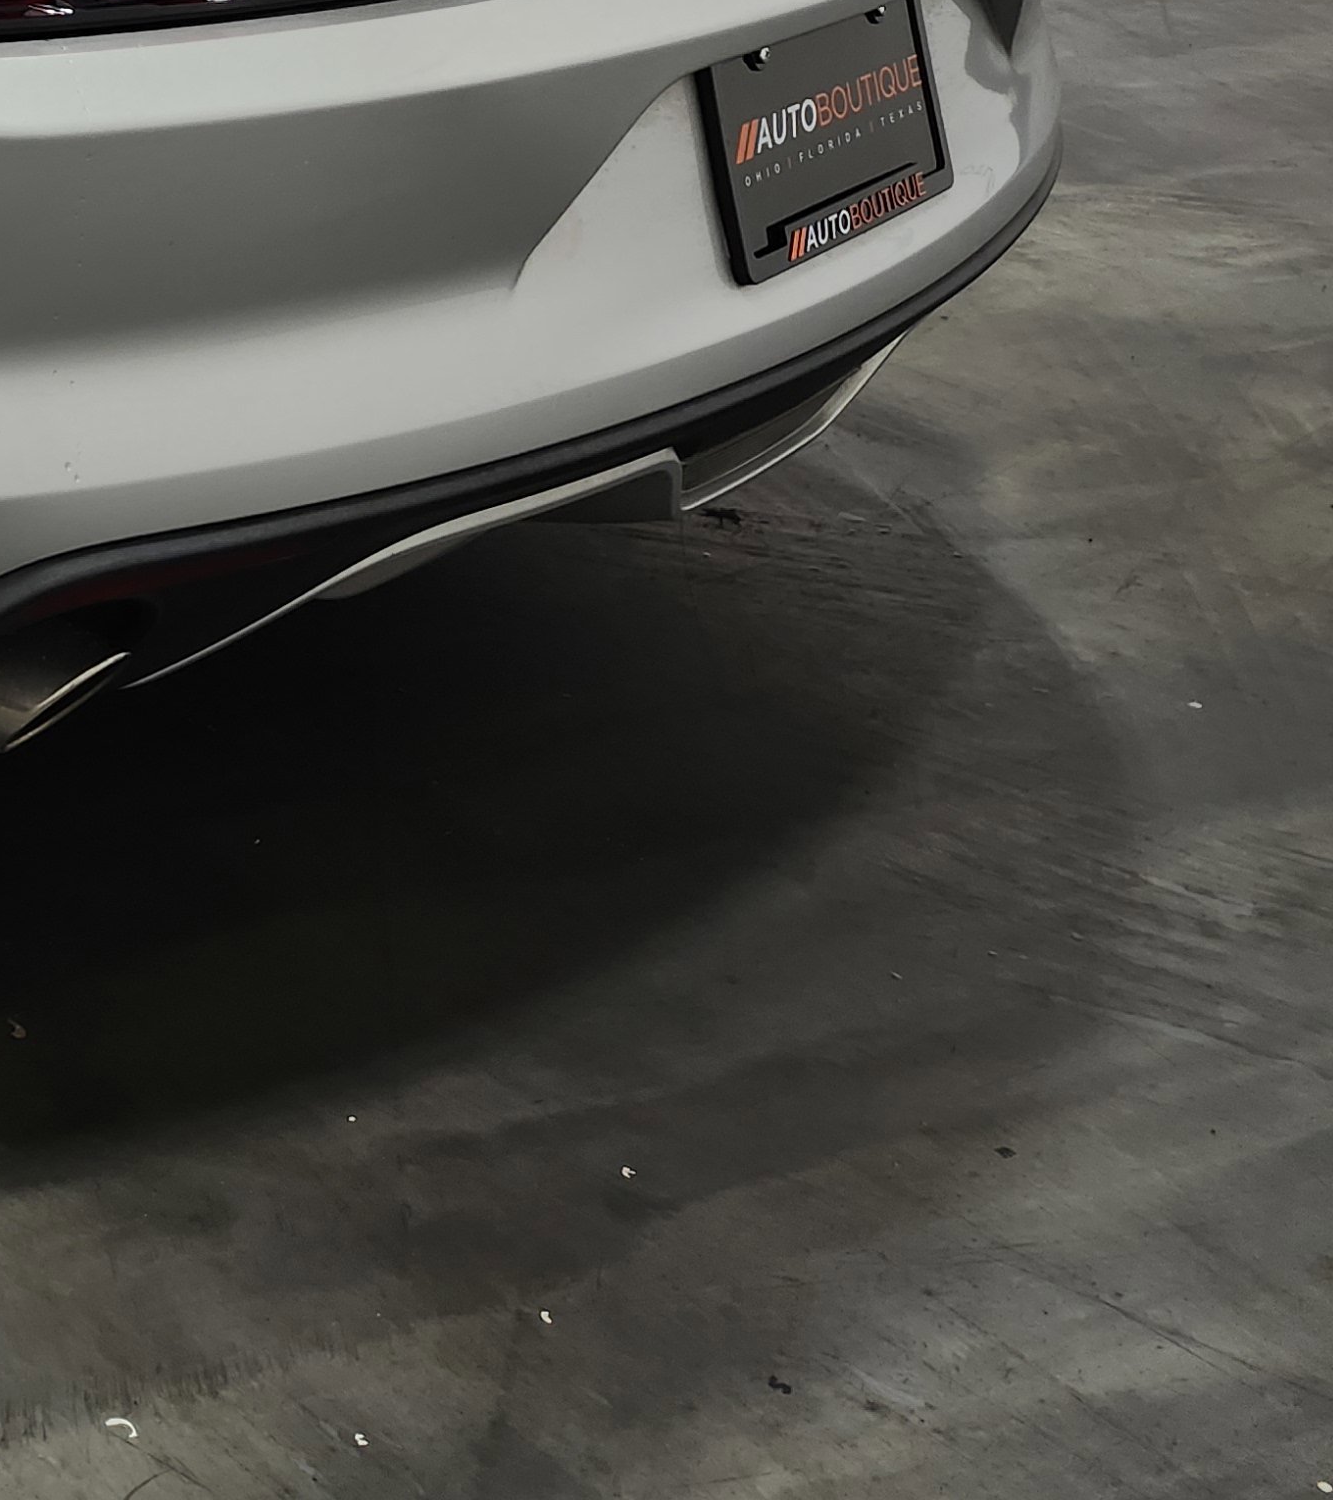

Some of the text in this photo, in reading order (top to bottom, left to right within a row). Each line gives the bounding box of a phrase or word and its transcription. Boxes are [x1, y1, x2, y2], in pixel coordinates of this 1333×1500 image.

[744, 100, 923, 188] OHIO FLORIDA TEXAS
[756, 54, 923, 155] AUTOBOUTIQUE
[805, 170, 928, 253] AUTOBOUTIQUE
